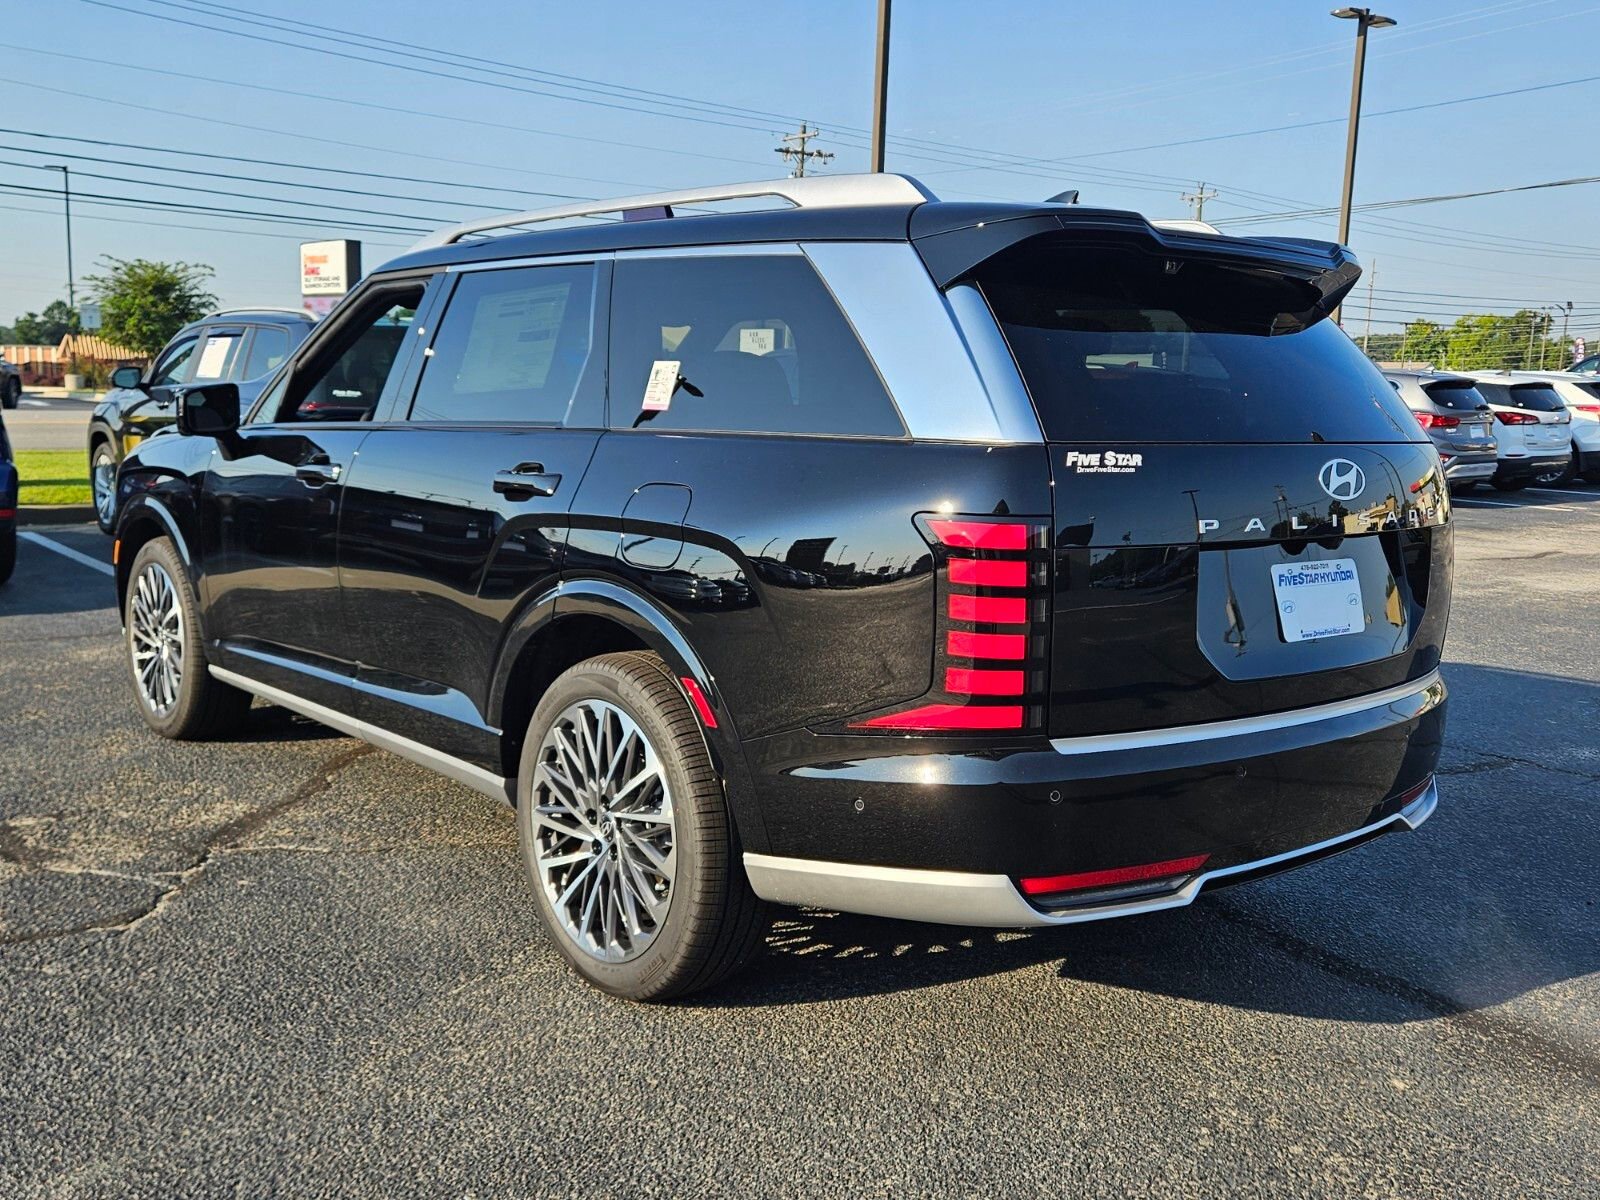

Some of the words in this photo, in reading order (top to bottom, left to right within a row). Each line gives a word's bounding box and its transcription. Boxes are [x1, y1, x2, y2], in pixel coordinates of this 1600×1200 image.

[1066, 451, 1101, 467] FIVE
[1104, 450, 1143, 467] STAR
[1198, 507, 1435, 534] PALISADE
